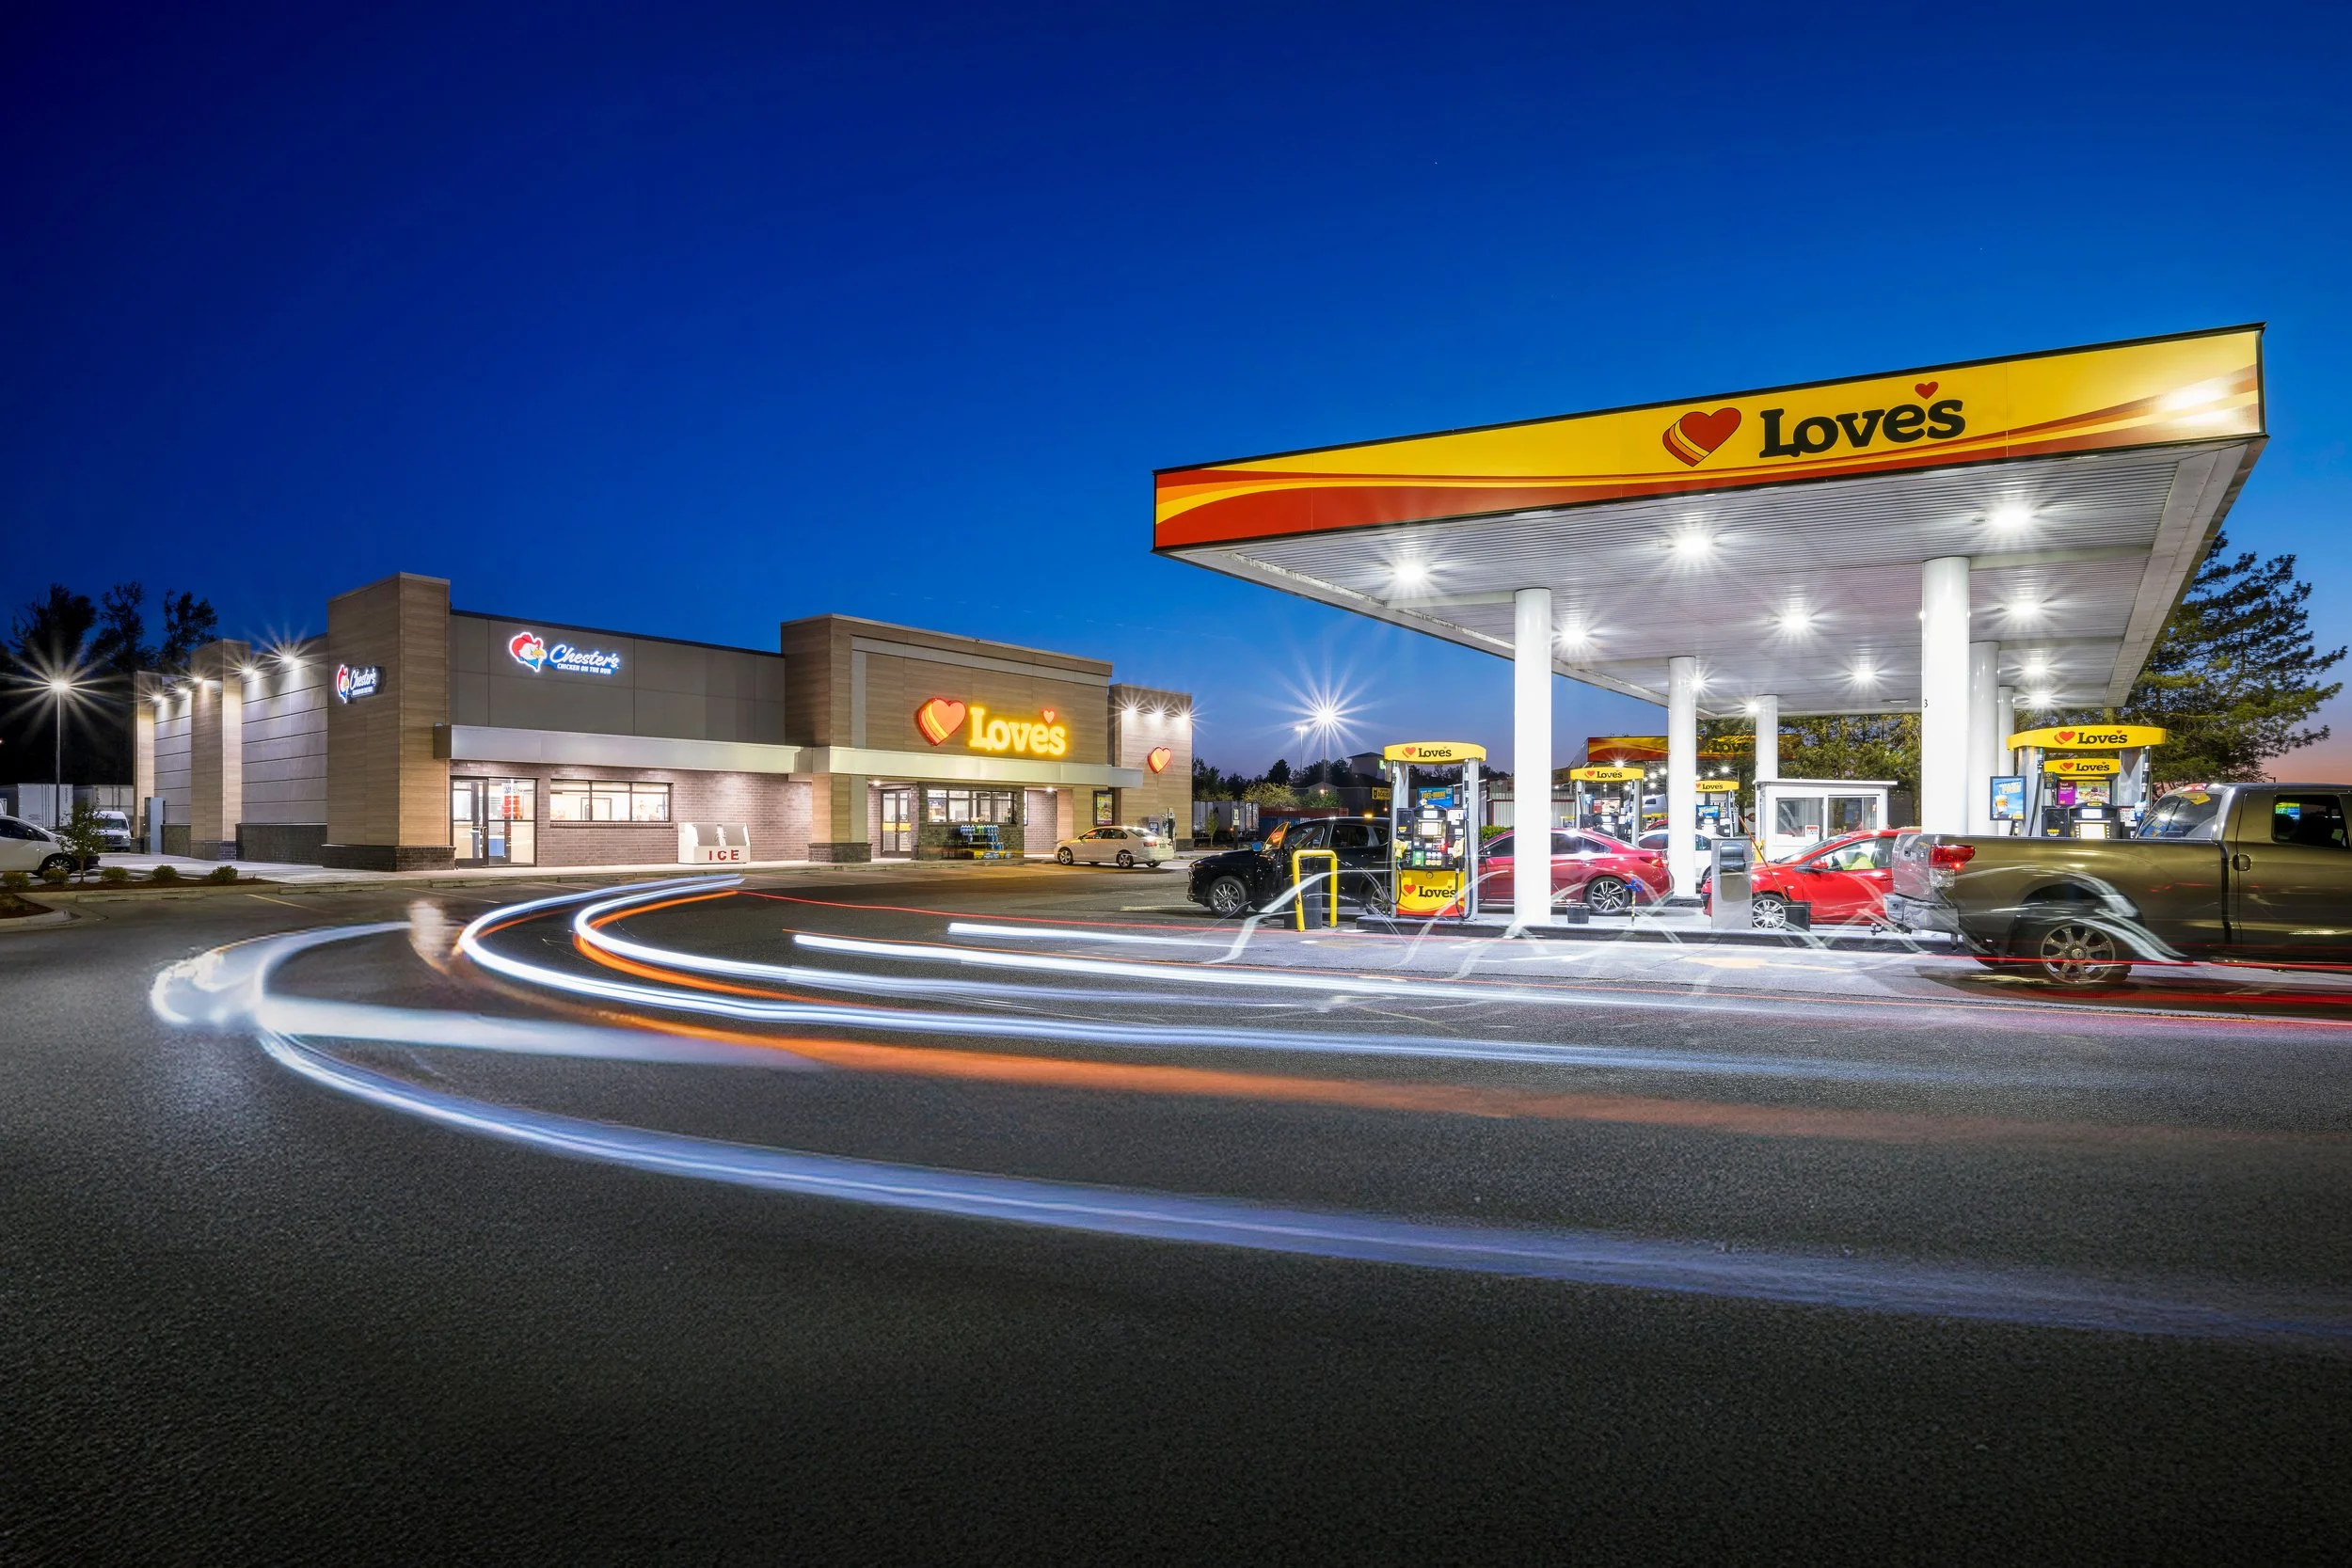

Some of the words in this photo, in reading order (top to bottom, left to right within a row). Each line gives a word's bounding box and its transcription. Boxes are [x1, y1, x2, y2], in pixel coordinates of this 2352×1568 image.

[549, 644, 620, 669] Chester's
[350, 668, 376, 689] Chester's
[708, 849, 739, 861] ICE
